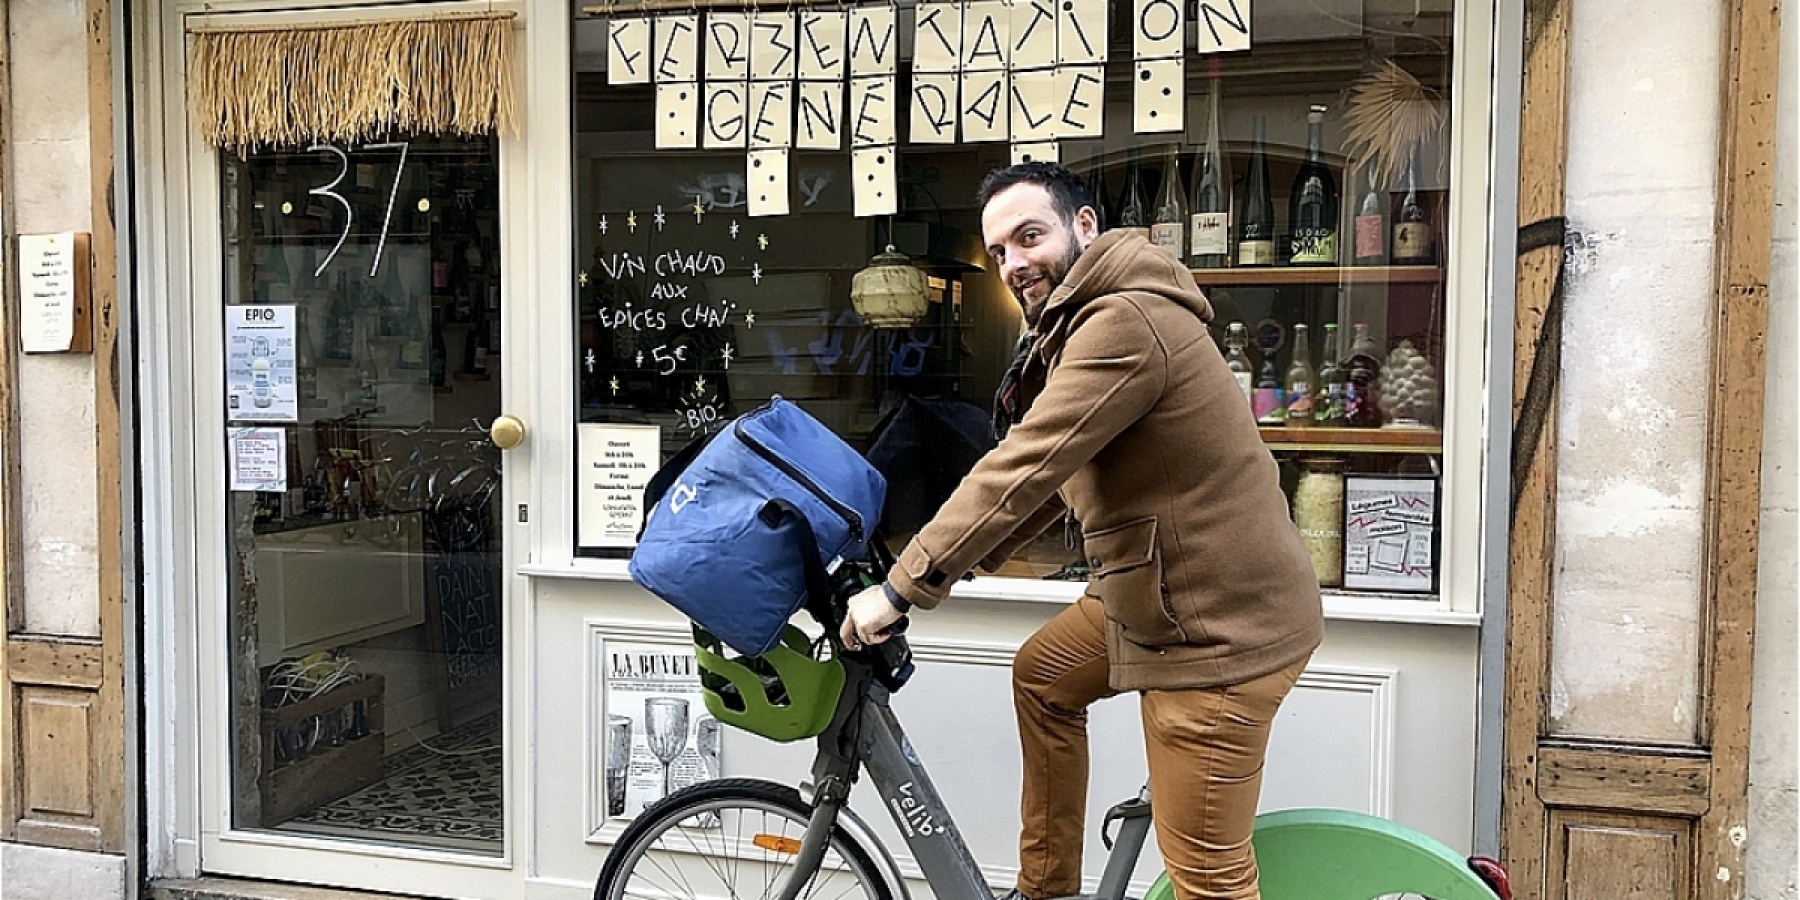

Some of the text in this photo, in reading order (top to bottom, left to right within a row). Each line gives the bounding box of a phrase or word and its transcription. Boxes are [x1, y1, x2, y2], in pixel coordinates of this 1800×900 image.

[307, 142, 408, 276] 37
[600, 249, 726, 280] VIN CHAUD
[651, 282, 688, 299] AUX
[599, 302, 666, 330] EPICES
[652, 344, 687, 375] 5€
[686, 402, 716, 429] BIO
[611, 653, 698, 677] LA BUVET
